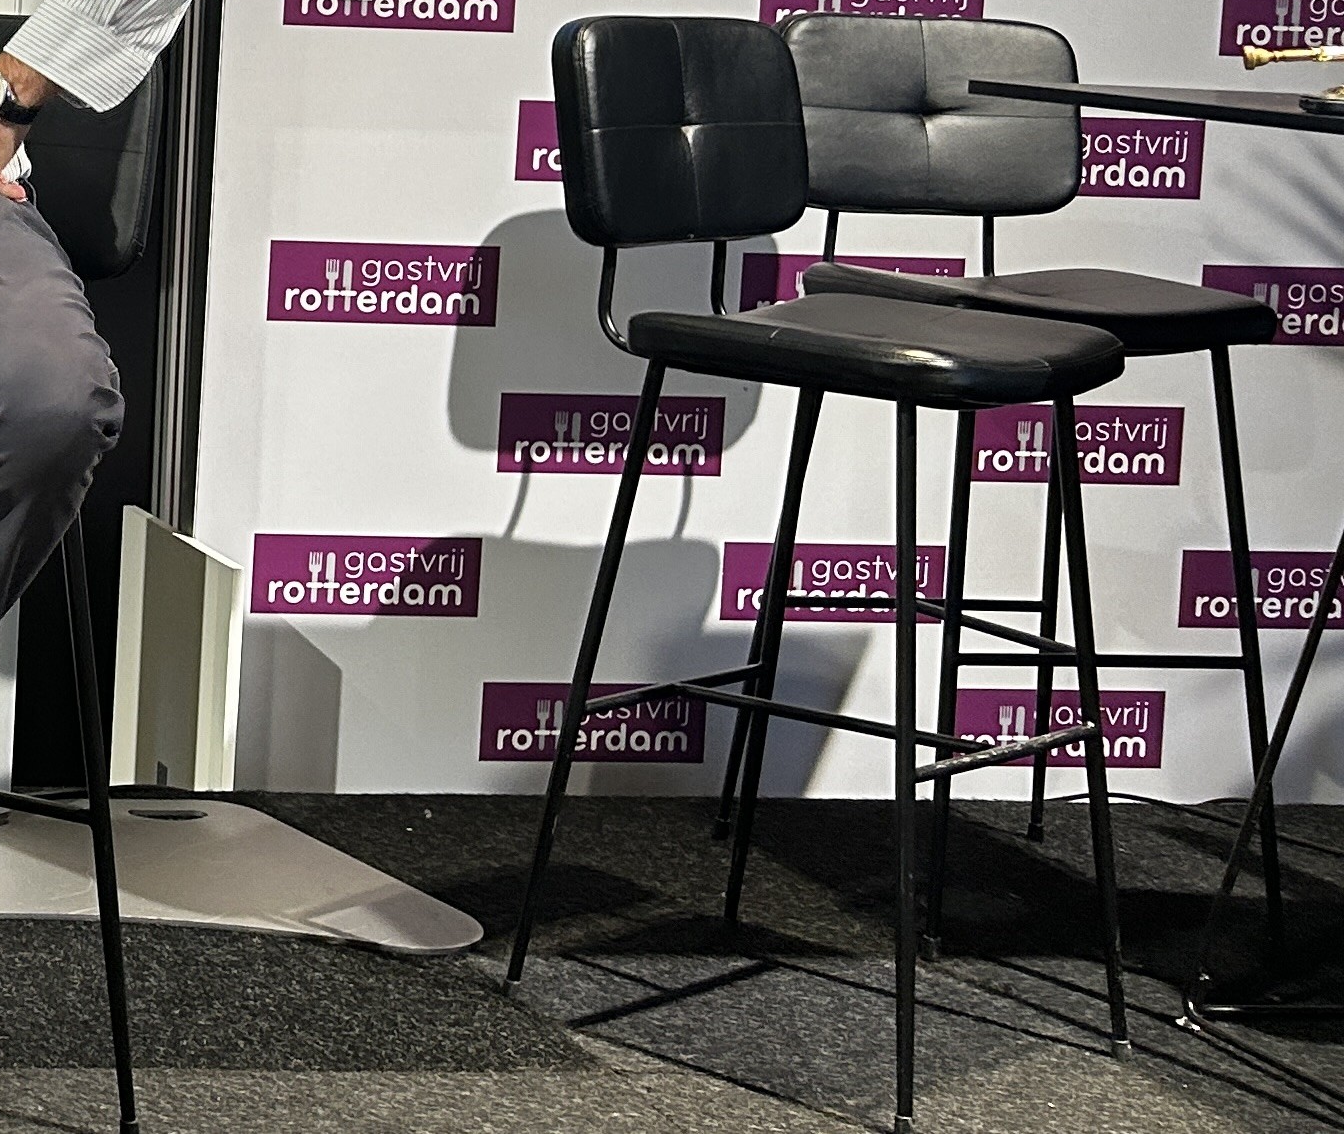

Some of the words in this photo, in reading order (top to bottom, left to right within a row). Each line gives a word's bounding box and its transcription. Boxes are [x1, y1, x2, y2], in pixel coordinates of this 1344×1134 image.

[1236, 19, 1344, 47] rotter
[360, 254, 482, 288] gastvrij
[283, 276, 481, 316] rotterdam
[590, 407, 709, 440] gatvrij
[1075, 416, 1168, 449] astvrij
[977, 442, 1165, 475] rottdam
[344, 545, 465, 579] gastvrij
[811, 555, 930, 588] gastvij
[267, 568, 464, 608] rotterdam
